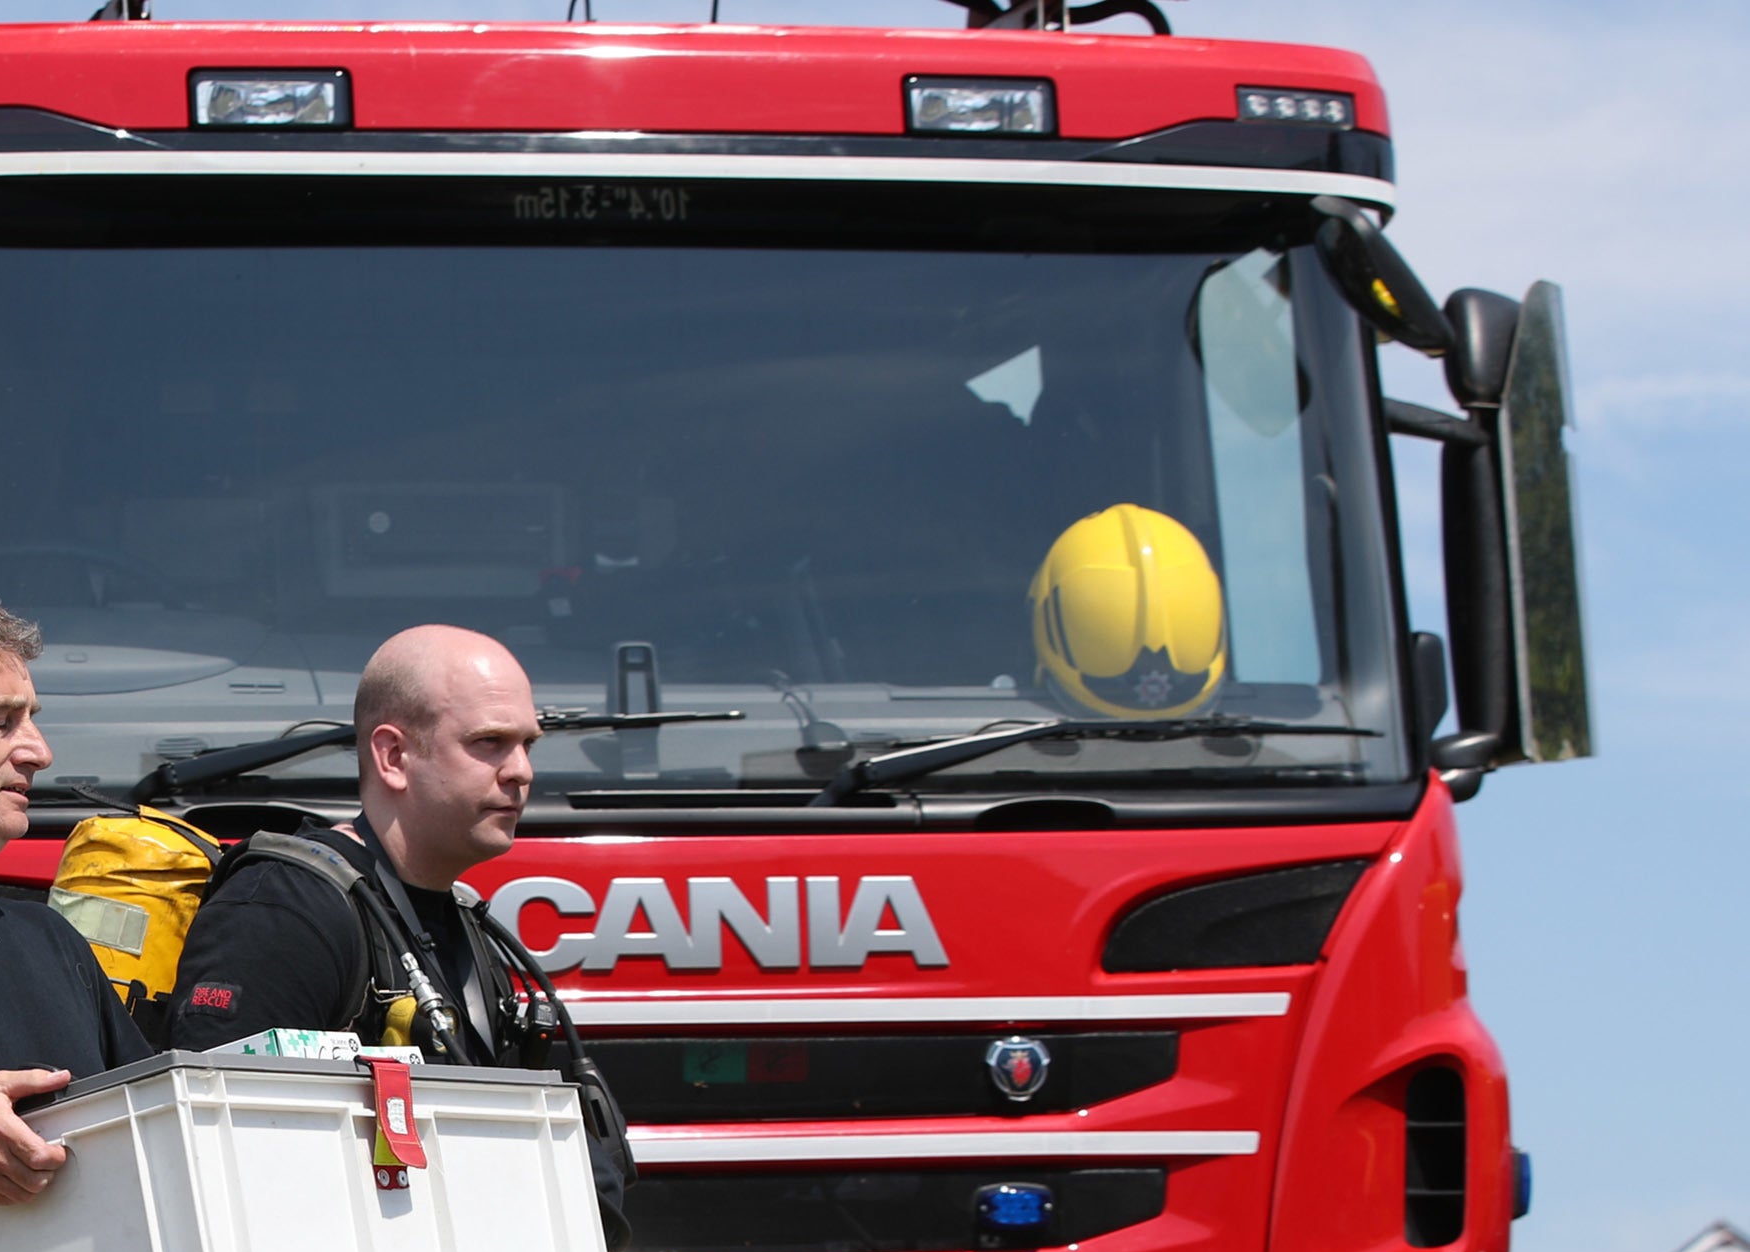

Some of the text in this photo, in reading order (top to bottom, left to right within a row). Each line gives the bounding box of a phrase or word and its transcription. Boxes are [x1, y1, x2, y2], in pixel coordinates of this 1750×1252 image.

[456, 875, 950, 974] CANIA
[194, 987, 233, 999] FIRE AND
[192, 996, 230, 1009] RESCUE
